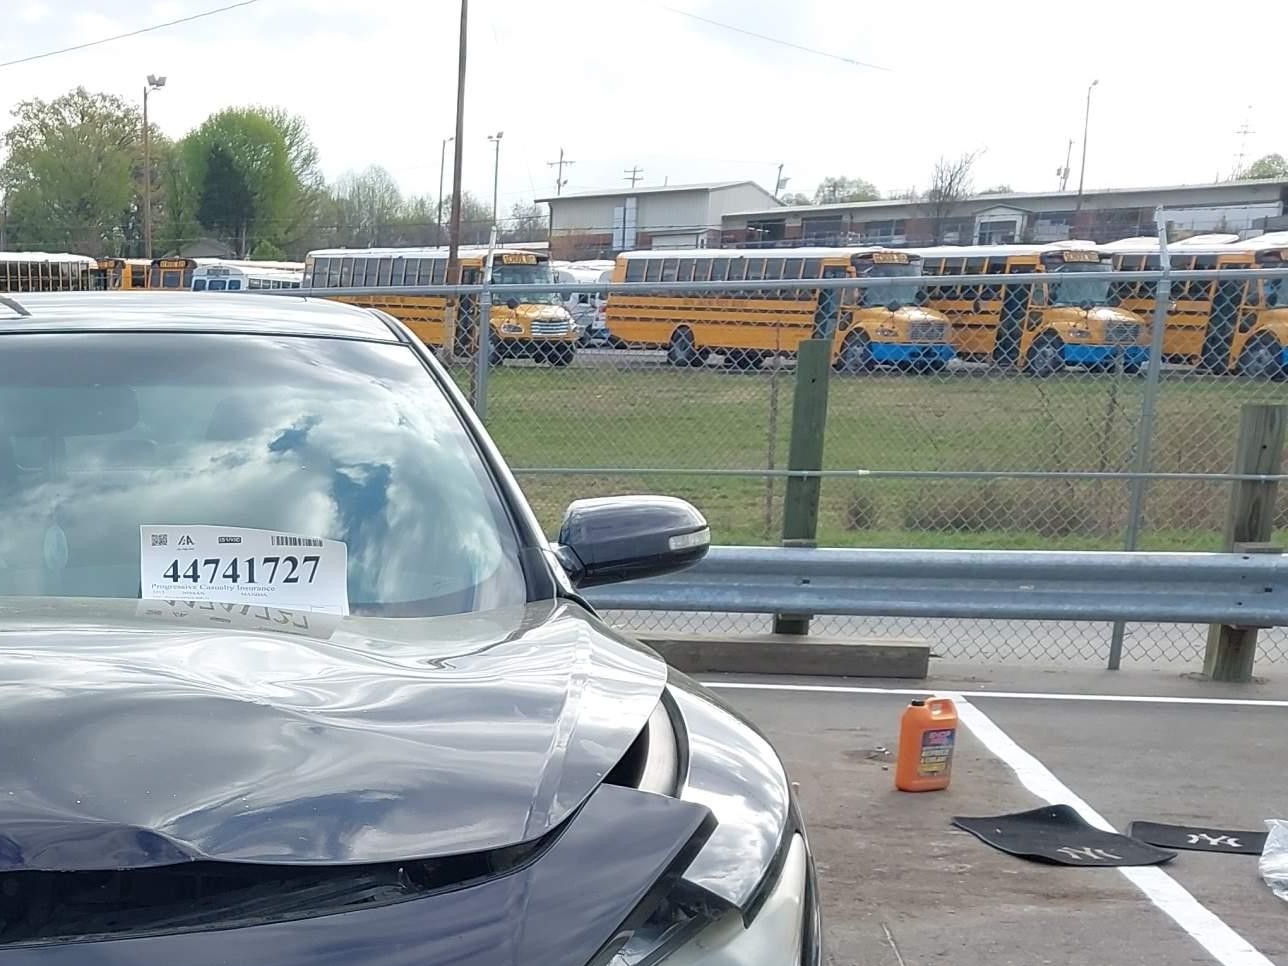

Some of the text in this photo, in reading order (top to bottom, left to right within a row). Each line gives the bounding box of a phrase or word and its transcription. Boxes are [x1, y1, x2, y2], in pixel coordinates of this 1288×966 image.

[163, 556, 320, 583] 44741727
[151, 583, 197, 591] Progressive
[199, 584, 234, 592] Casualty
